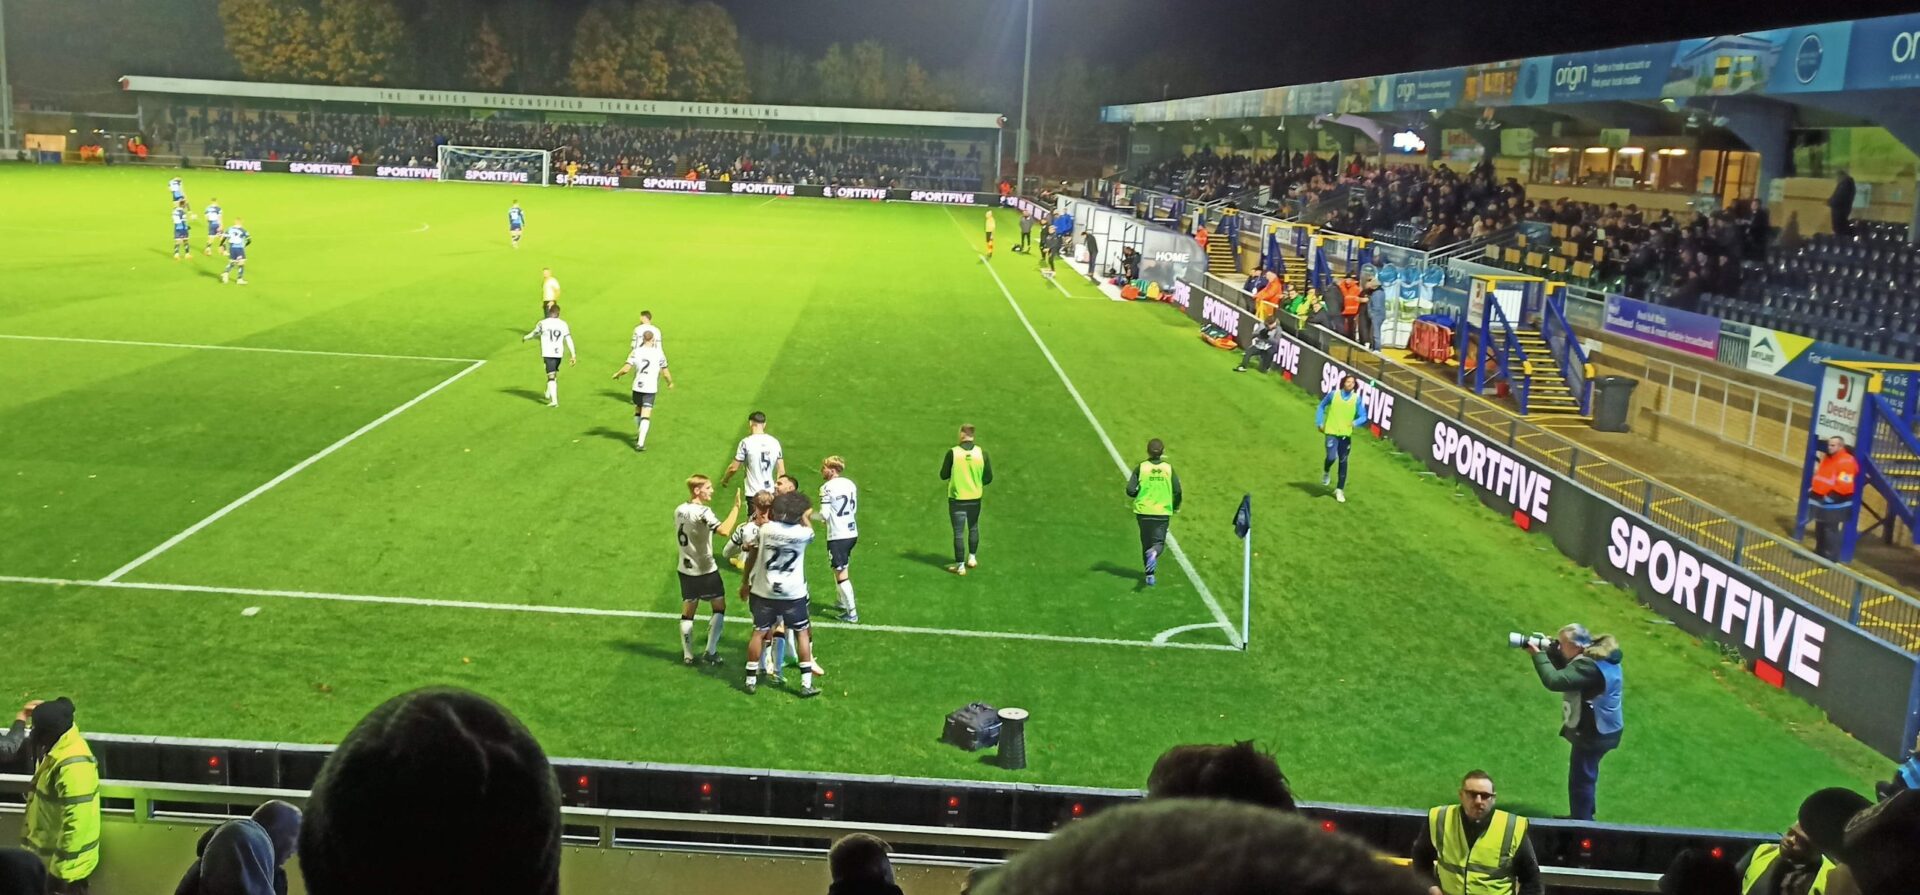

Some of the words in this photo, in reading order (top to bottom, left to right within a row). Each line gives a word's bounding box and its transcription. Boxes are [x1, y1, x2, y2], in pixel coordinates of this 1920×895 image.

[380, 92, 401, 101] THE
[419, 94, 467, 104] WHITES
[484, 96, 583, 109] BEACONSFIELD
[600, 101, 656, 113] TERRACE
[680, 105, 779, 118] #KEEPSMILING
[289, 162, 353, 175] SPORTFIVE
[376, 166, 440, 179] SPORTFIVE
[464, 169, 528, 182] SPORTFIVE
[643, 178, 707, 191] SPORTFIVE
[731, 182, 795, 195] SPORTFIVE
[823, 186, 887, 199] SORTFIVE
[910, 190, 974, 204] SPORTFIVE
[1155, 251, 1190, 263] HOME
[1203, 295, 1240, 337] SPORTFIVE
[547, 329, 561, 342] 19
[640, 359, 650, 374] 2
[1321, 361, 1394, 430] SPOTFIVE
[1827, 401, 1857, 421] Deeter
[760, 452, 771, 472] 5
[1432, 421, 1552, 524] SPORTFIVE
[836, 492, 857, 517] 26
[678, 523, 689, 547] 6
[765, 544, 799, 574] 22
[1607, 516, 1826, 687] SPORTFIVE
